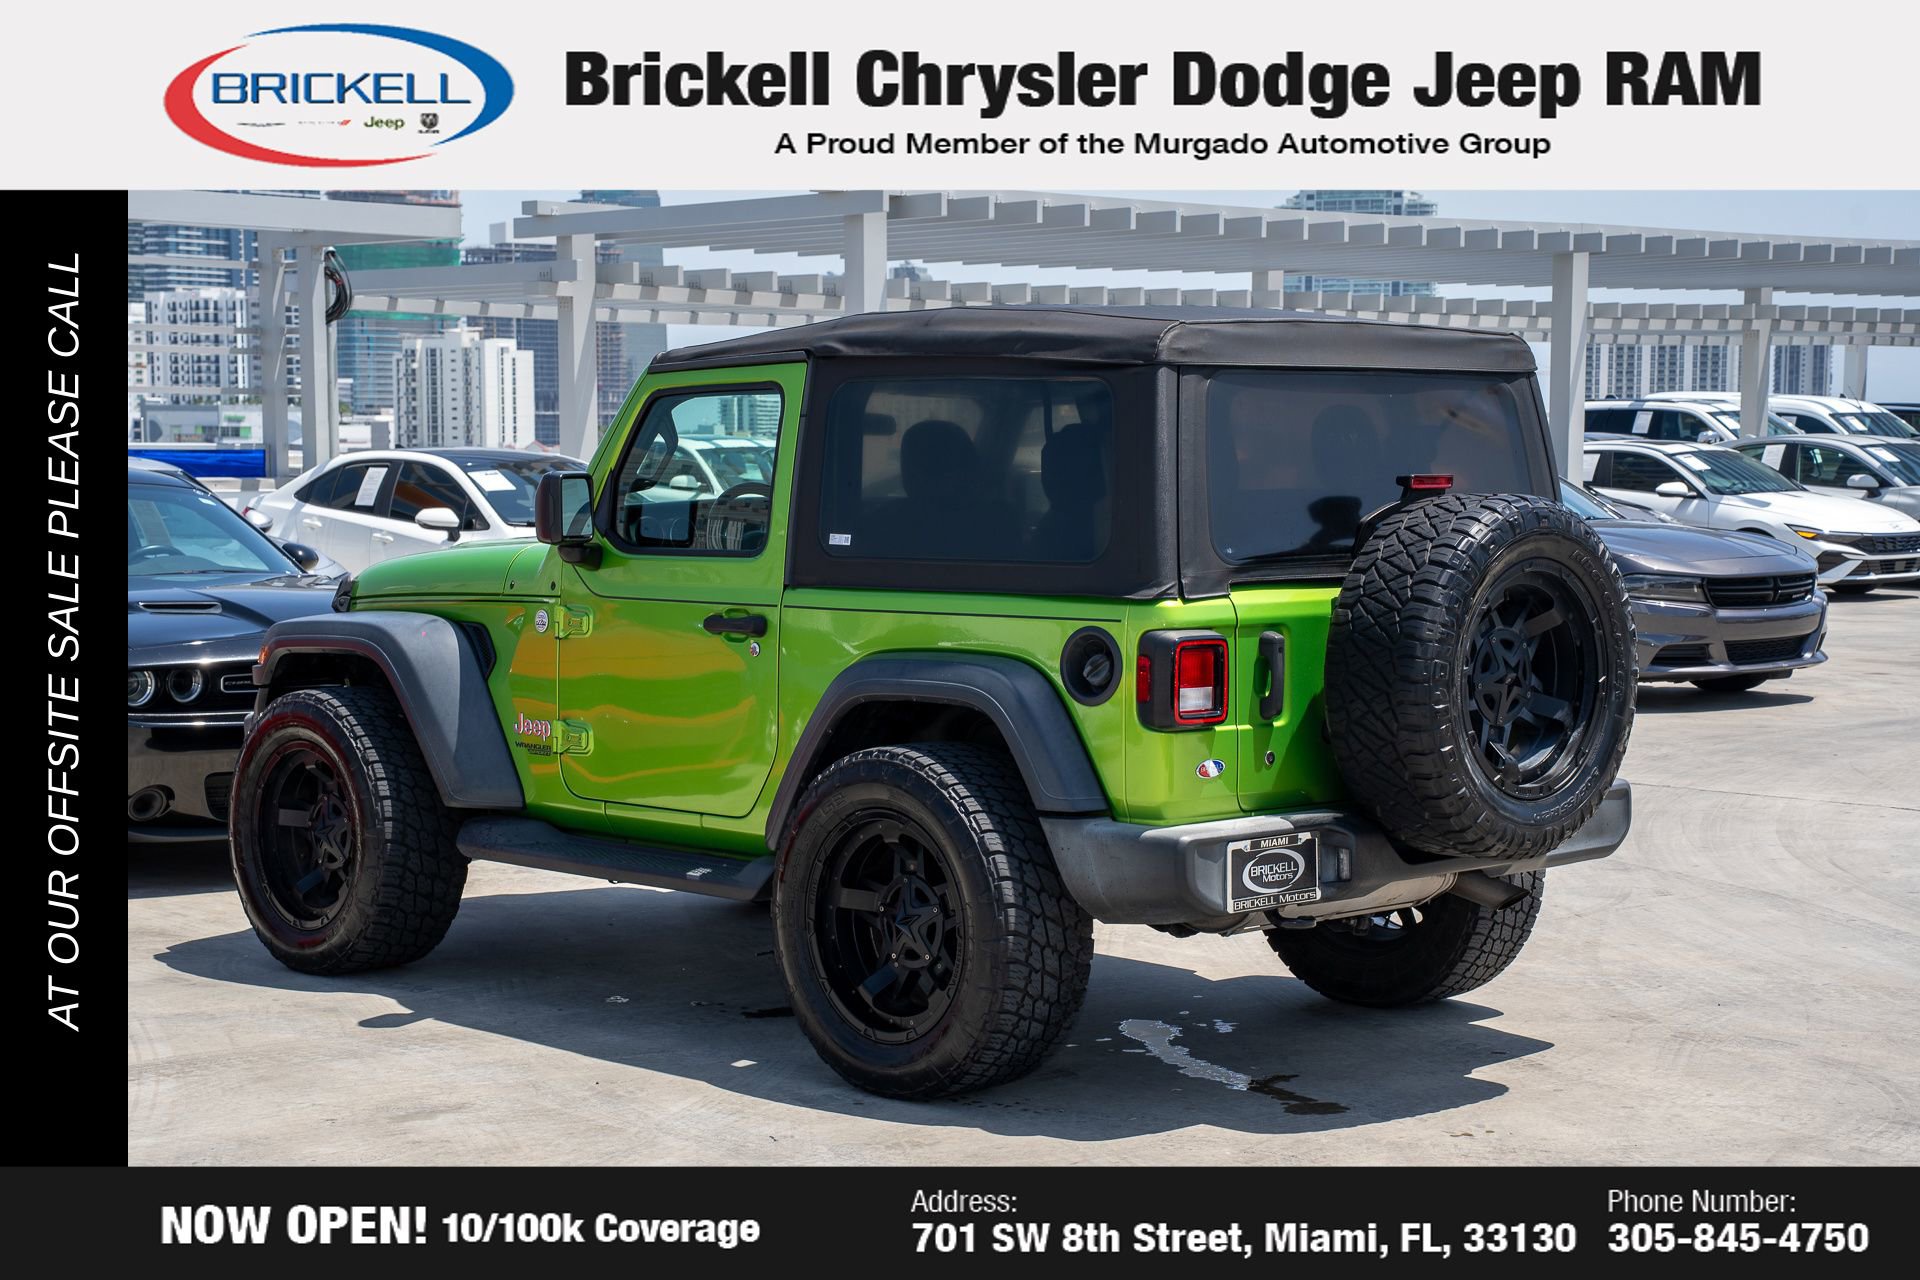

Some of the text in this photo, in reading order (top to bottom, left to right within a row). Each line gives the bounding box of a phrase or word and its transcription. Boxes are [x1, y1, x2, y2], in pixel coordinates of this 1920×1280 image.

[514, 712, 551, 742] Jeep
[515, 741, 552, 751] WRANGLER
[1260, 836, 1289, 849] MIAMI
[1250, 861, 1298, 878] BRICKELL
[1262, 872, 1294, 883] Motors
[1234, 890, 1316, 911] BRICKELL Motors
